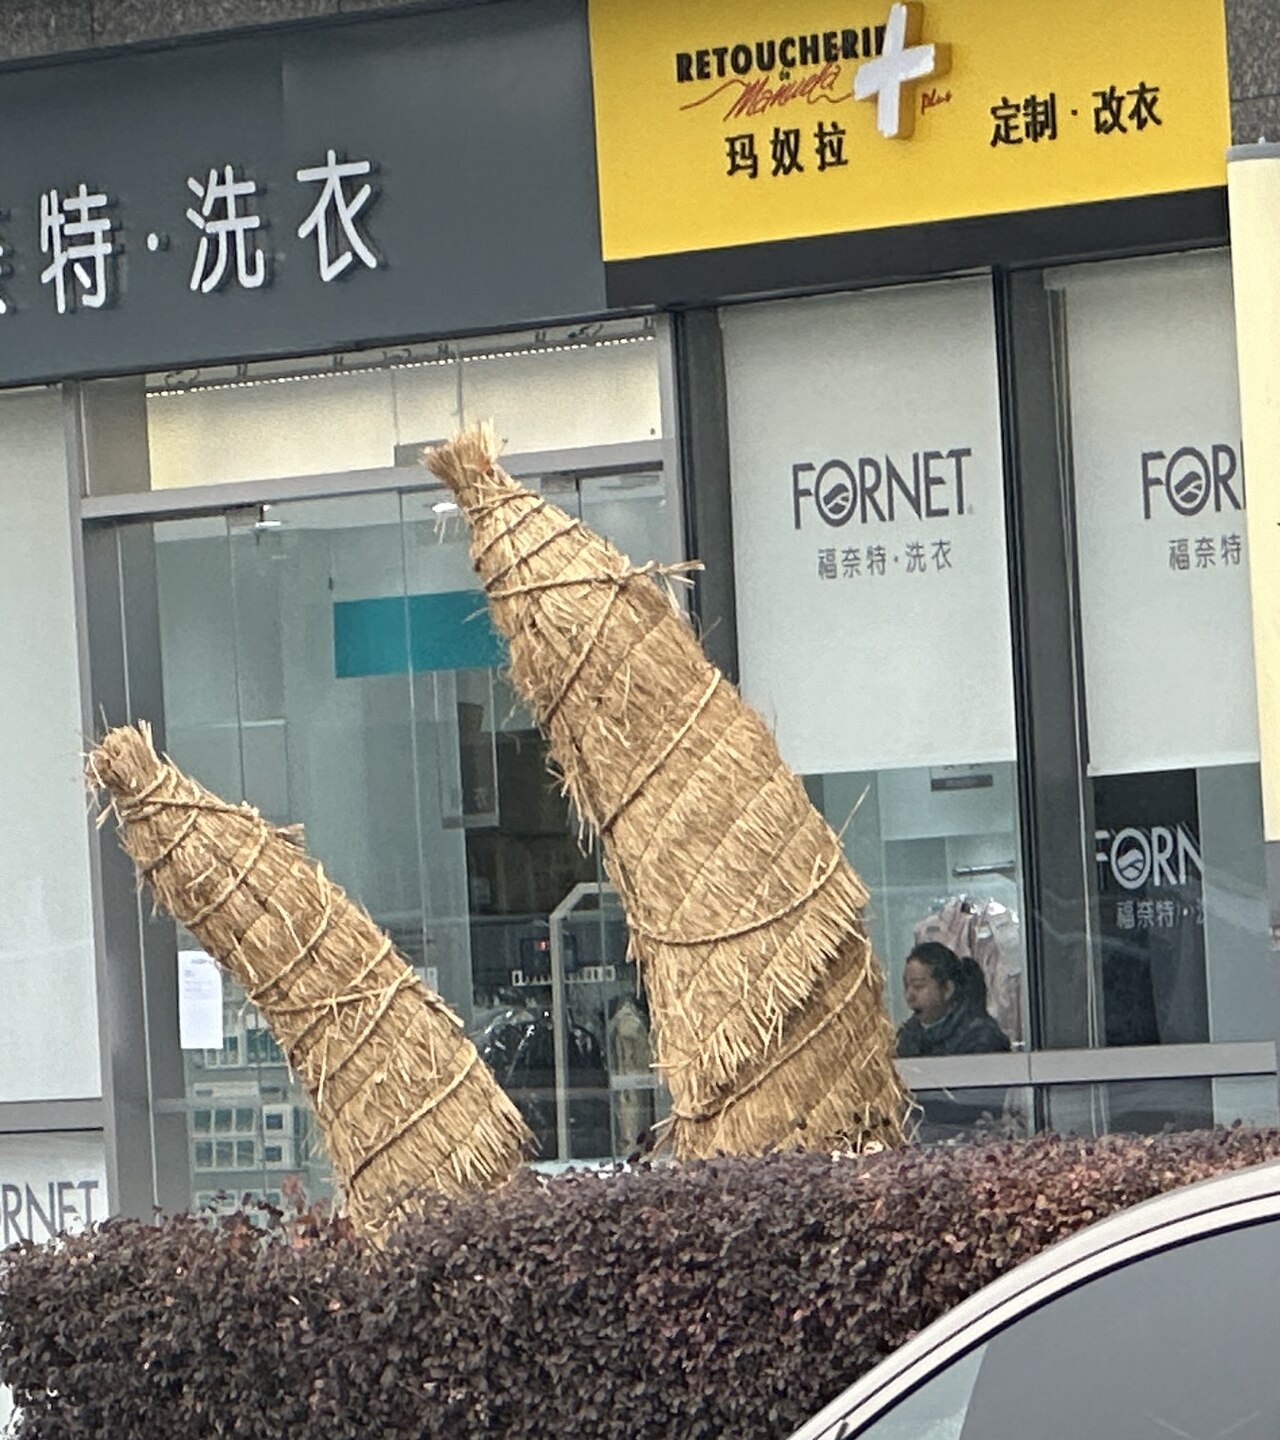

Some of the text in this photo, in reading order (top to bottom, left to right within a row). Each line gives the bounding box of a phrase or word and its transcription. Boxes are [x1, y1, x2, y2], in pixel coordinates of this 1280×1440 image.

[989, 82, 1163, 147] 定制·改衣
[725, 120, 849, 179] 玛奴拉
[0, 149, 379, 315] 特·洗衣
[792, 447, 972, 530] FORNET
[1141, 443, 1246, 520] FOR
[817, 538, 953, 580] 福奈特·洗衣
[1168, 532, 1242, 571] 福奈特
[1116, 900, 1206, 930] 福奈特·
